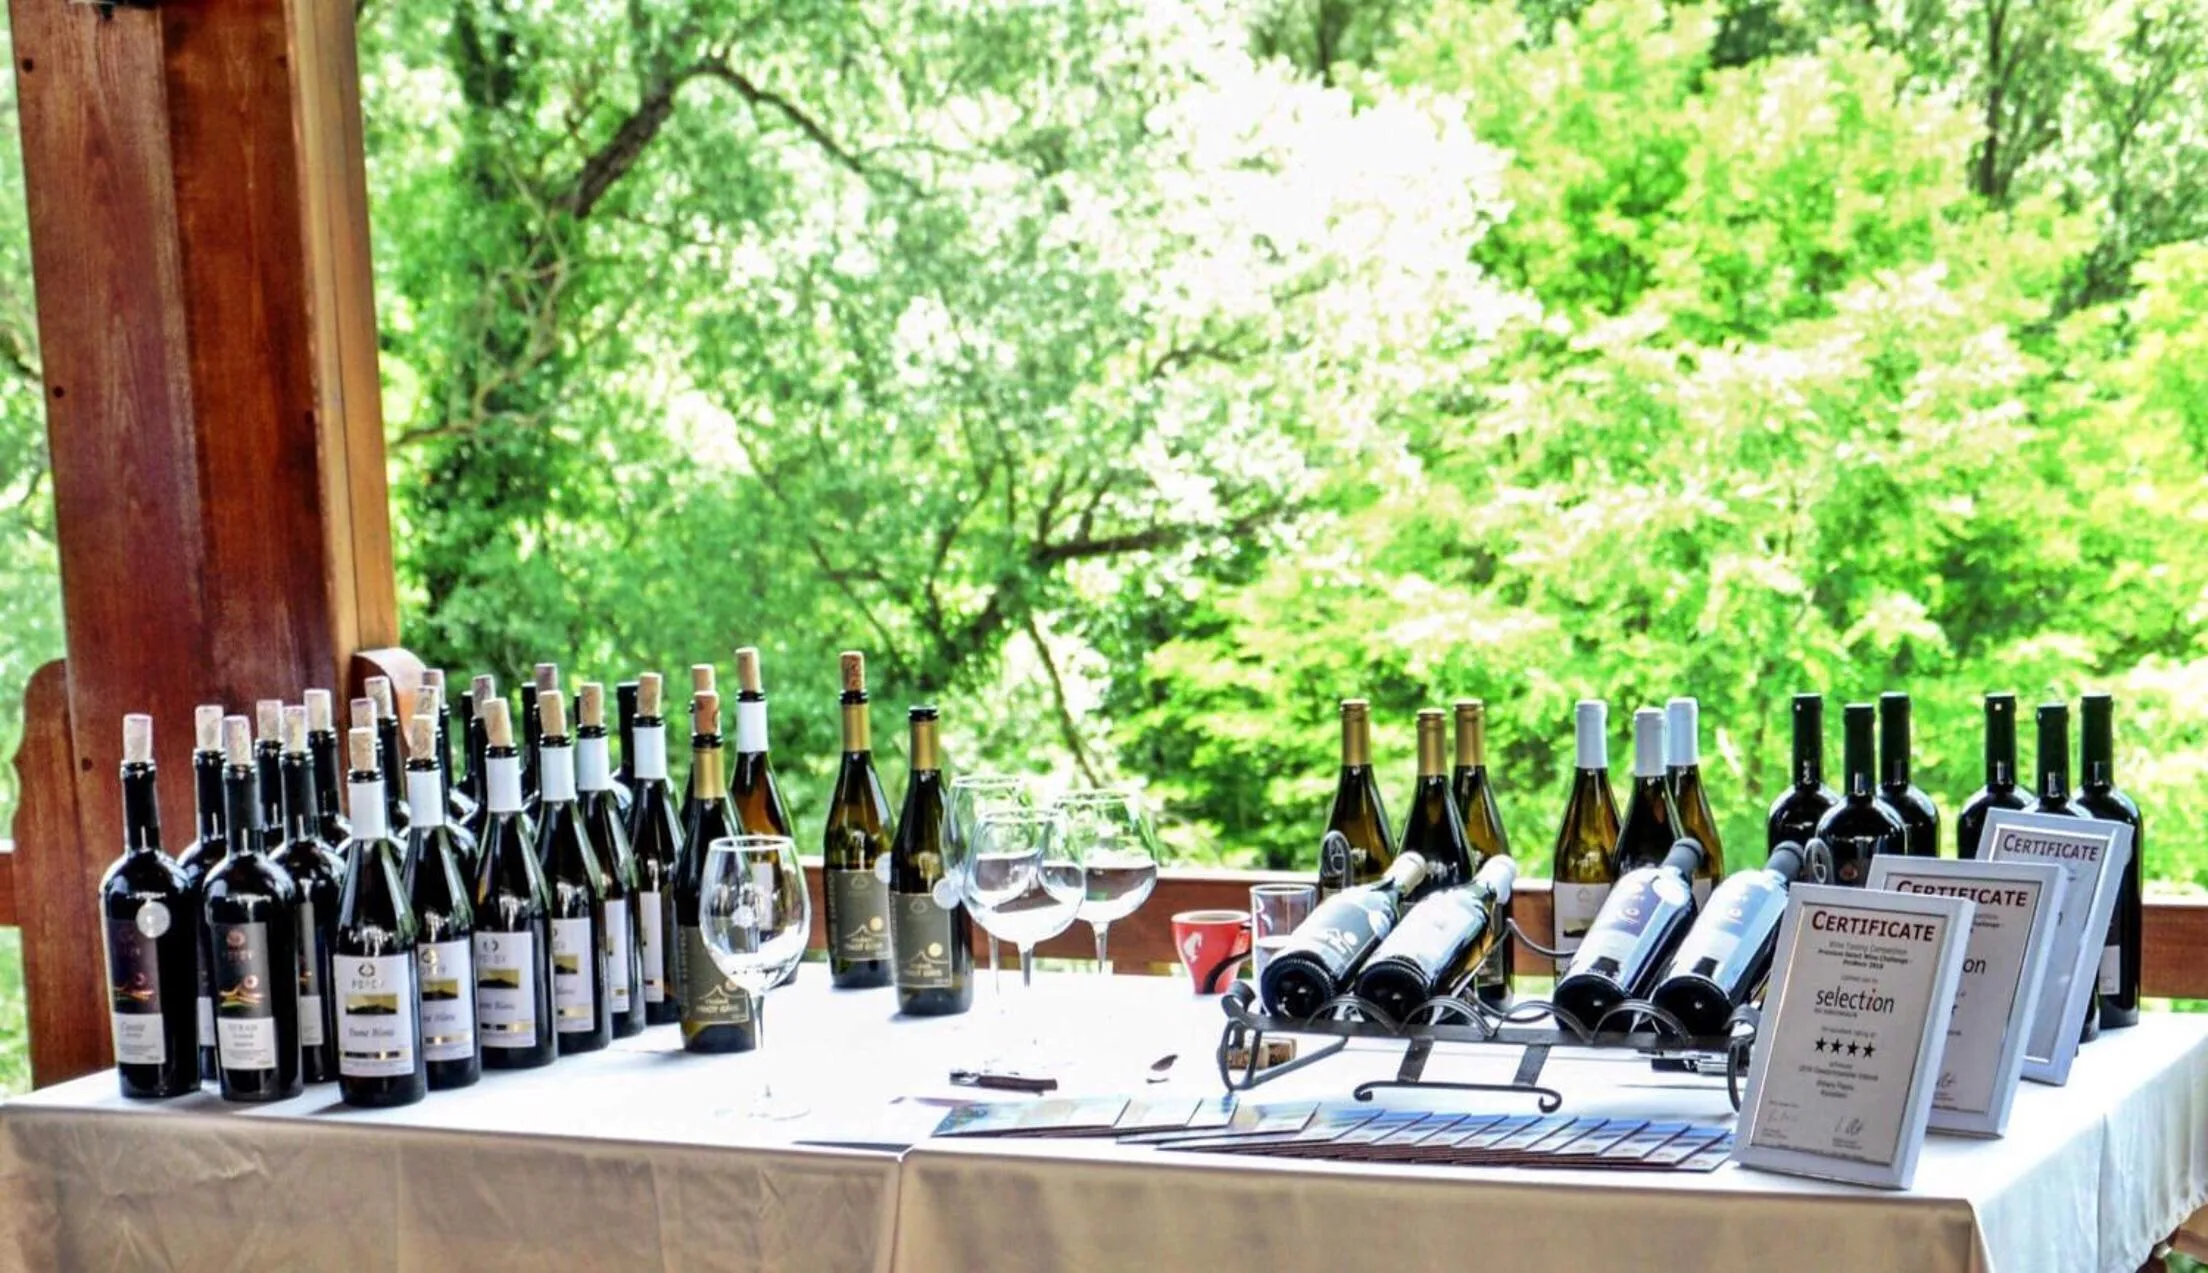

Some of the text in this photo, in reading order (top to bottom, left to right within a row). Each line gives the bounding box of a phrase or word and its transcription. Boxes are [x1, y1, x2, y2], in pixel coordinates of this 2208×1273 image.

[2003, 833, 2099, 861] CERTIFICATE
[1811, 910, 1936, 942] CERTIFICATE
[1815, 985, 1895, 1014] selection
